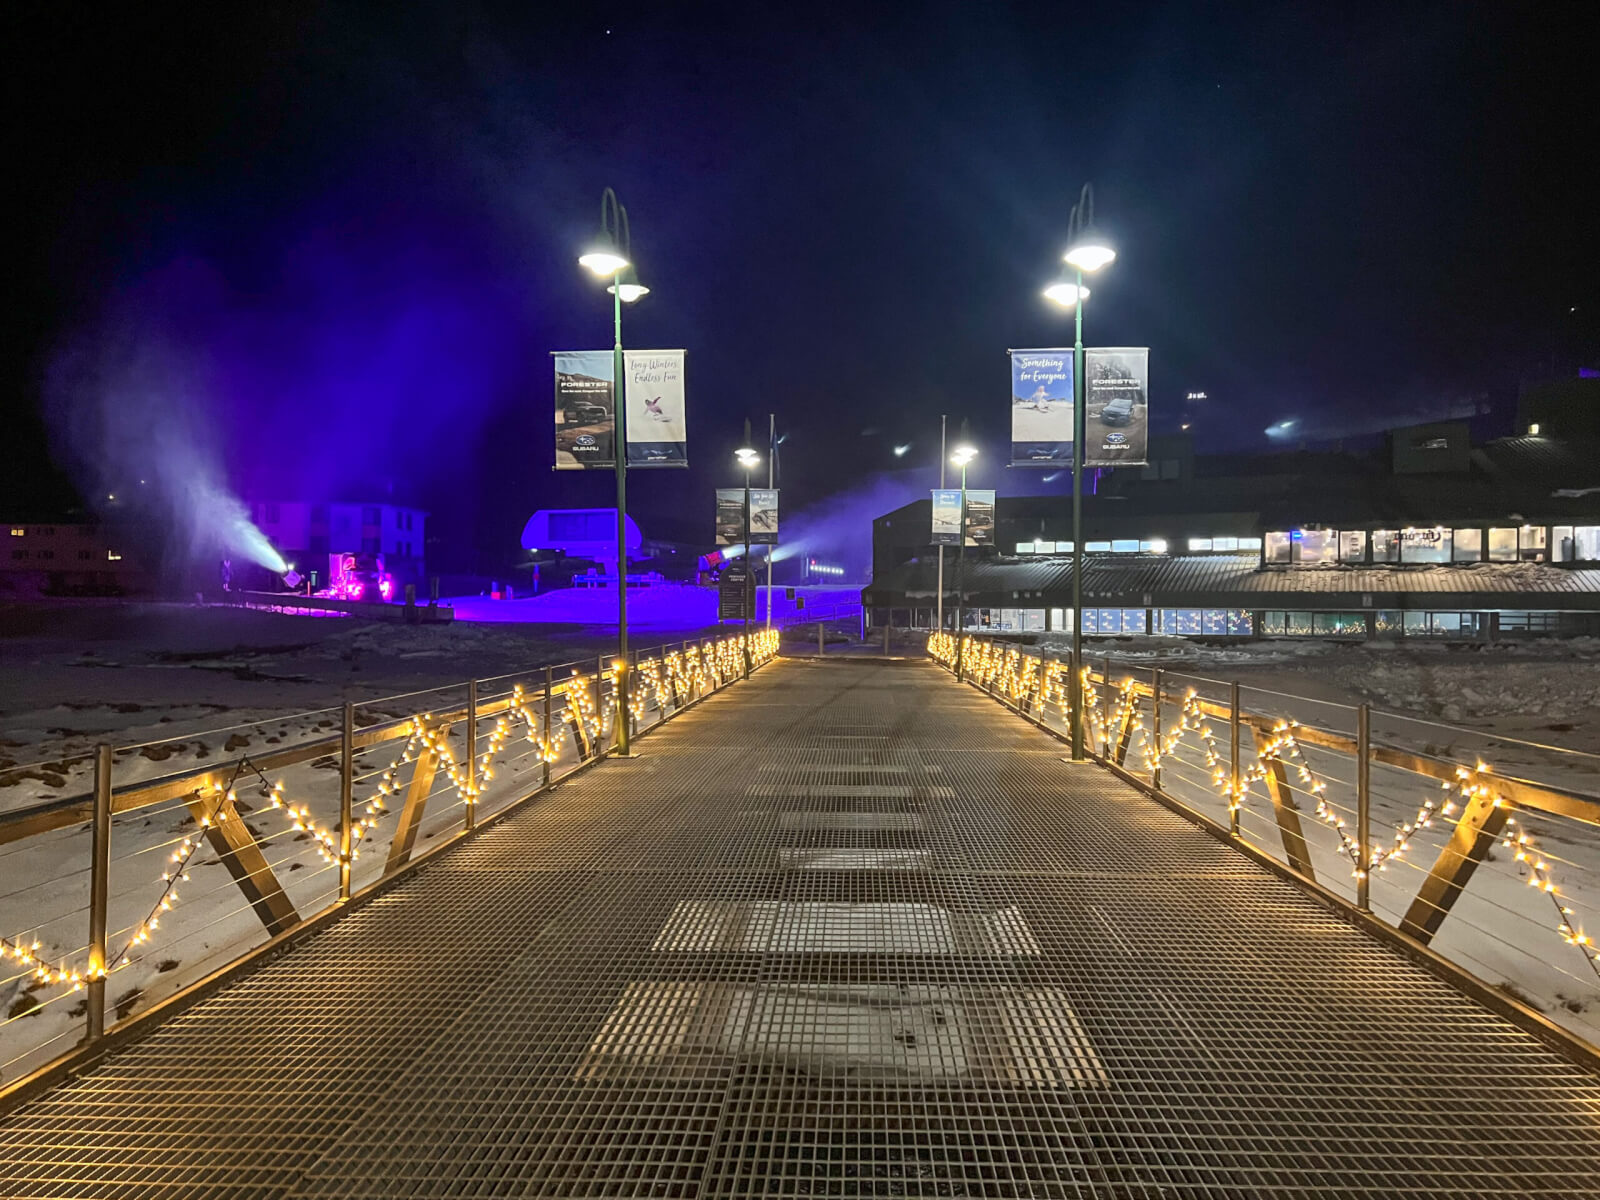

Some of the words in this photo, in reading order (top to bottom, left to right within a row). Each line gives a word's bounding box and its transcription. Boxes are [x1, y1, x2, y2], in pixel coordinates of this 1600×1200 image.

[630, 360, 646, 370] Long
[649, 360, 677, 369] Winters
[1021, 358, 1064, 371] Something
[634, 372, 660, 383] Endless
[663, 372, 676, 382] Fun
[1020, 371, 1030, 381] for
[1033, 370, 1067, 384] Everyone
